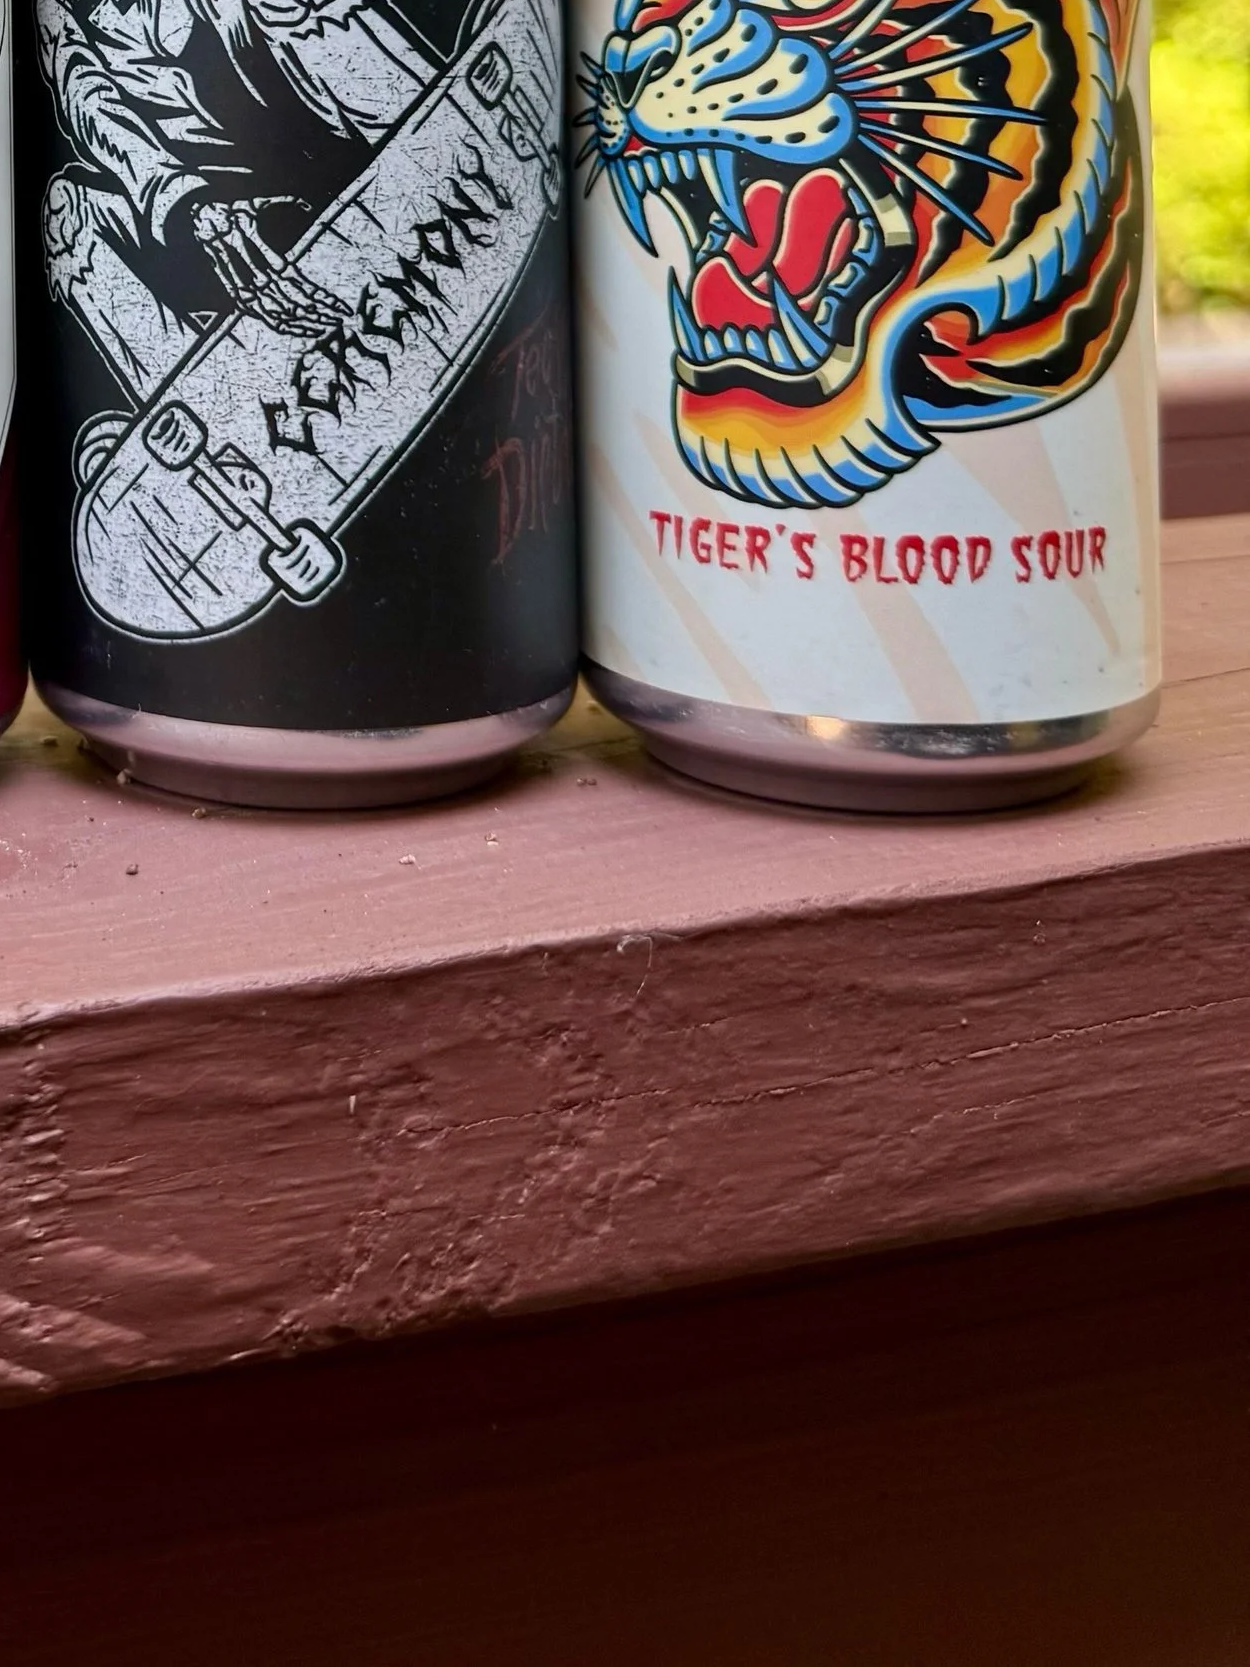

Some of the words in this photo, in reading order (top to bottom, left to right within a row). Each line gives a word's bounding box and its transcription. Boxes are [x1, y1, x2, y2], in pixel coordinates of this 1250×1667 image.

[258, 133, 514, 456] CEREMONY
[650, 509, 817, 579] TIGER'S
[839, 532, 992, 585] BLOOD
[1013, 525, 1107, 584] SOUR
